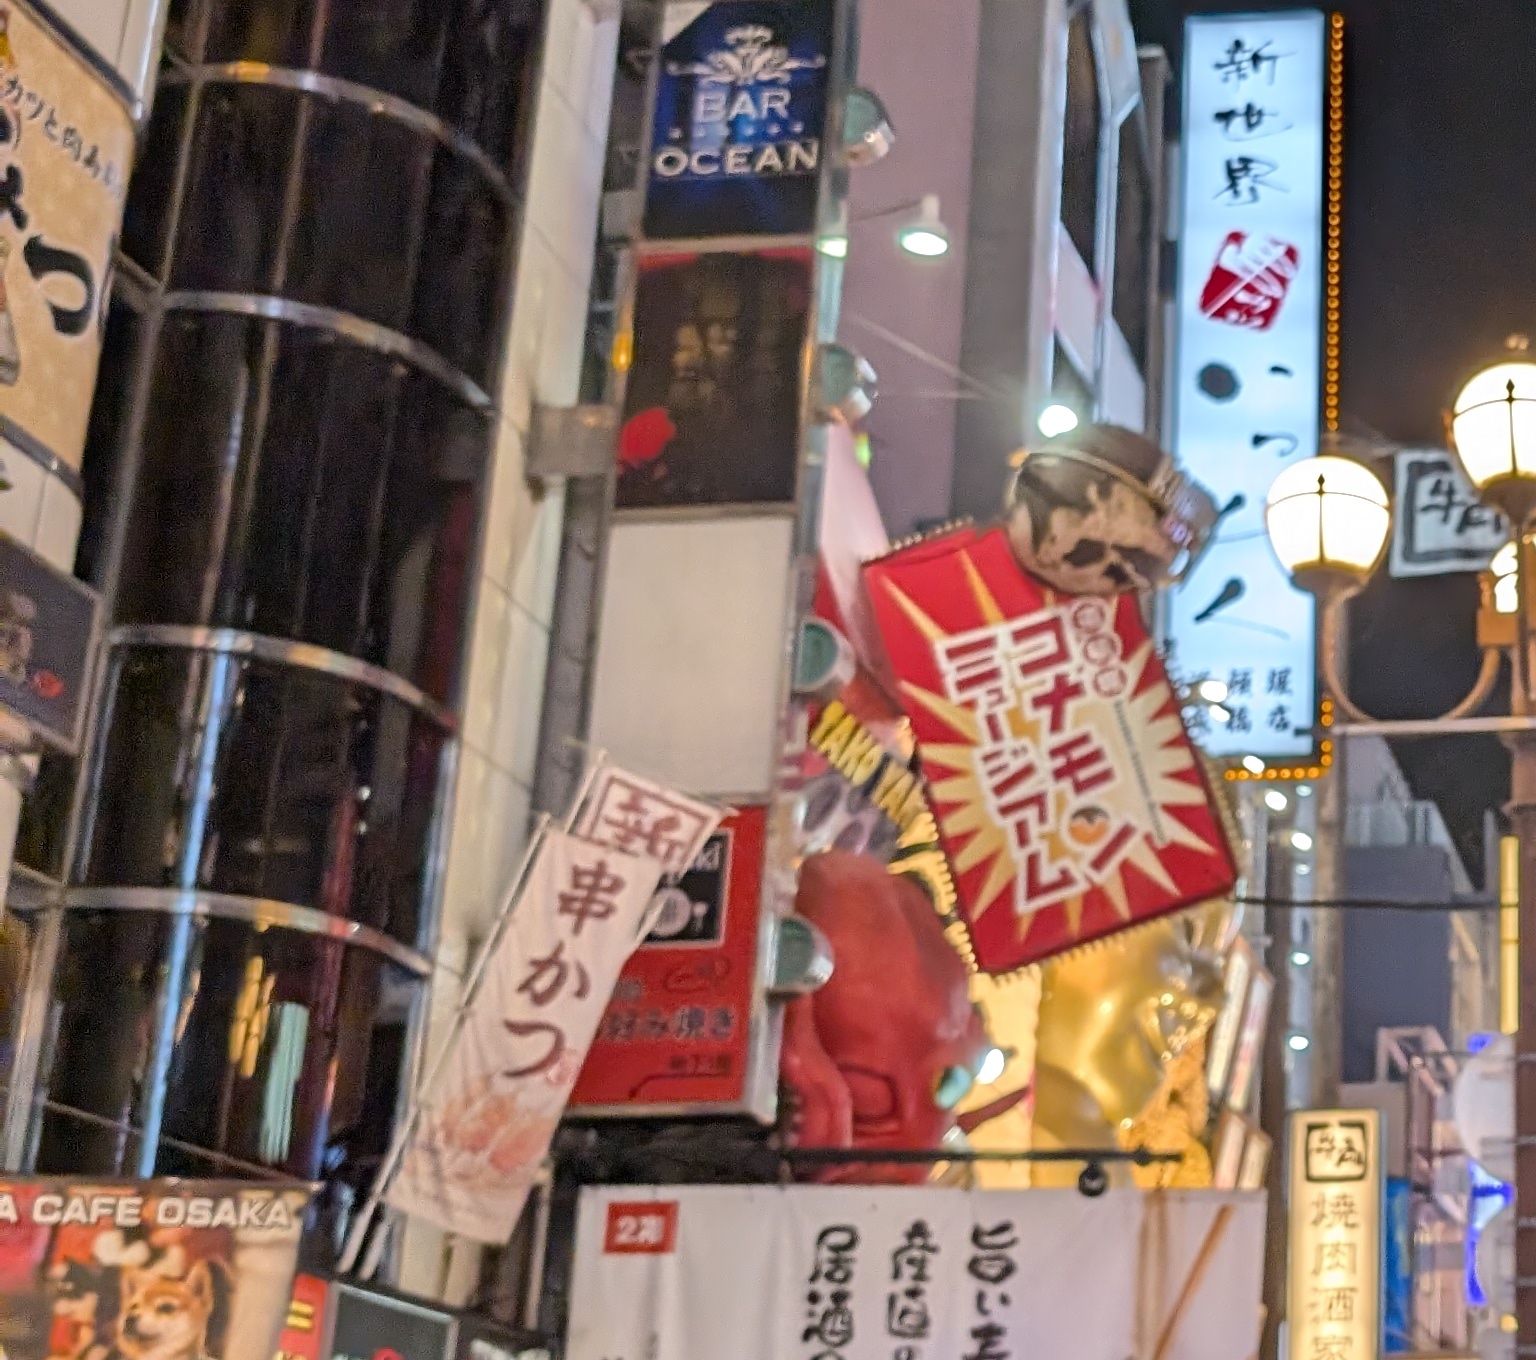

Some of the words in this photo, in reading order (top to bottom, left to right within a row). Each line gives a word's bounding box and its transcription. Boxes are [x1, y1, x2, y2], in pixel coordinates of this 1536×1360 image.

[698, 88, 793, 124] BAR
[1212, 38, 1292, 207] 新世界
[652, 142, 821, 177] OCEAN
[942, 630, 1084, 908] ミュージアム
[500, 860, 625, 1080] 串かつ
[32, 1194, 143, 1228] CAFE
[156, 1196, 291, 1228] OSAKA
